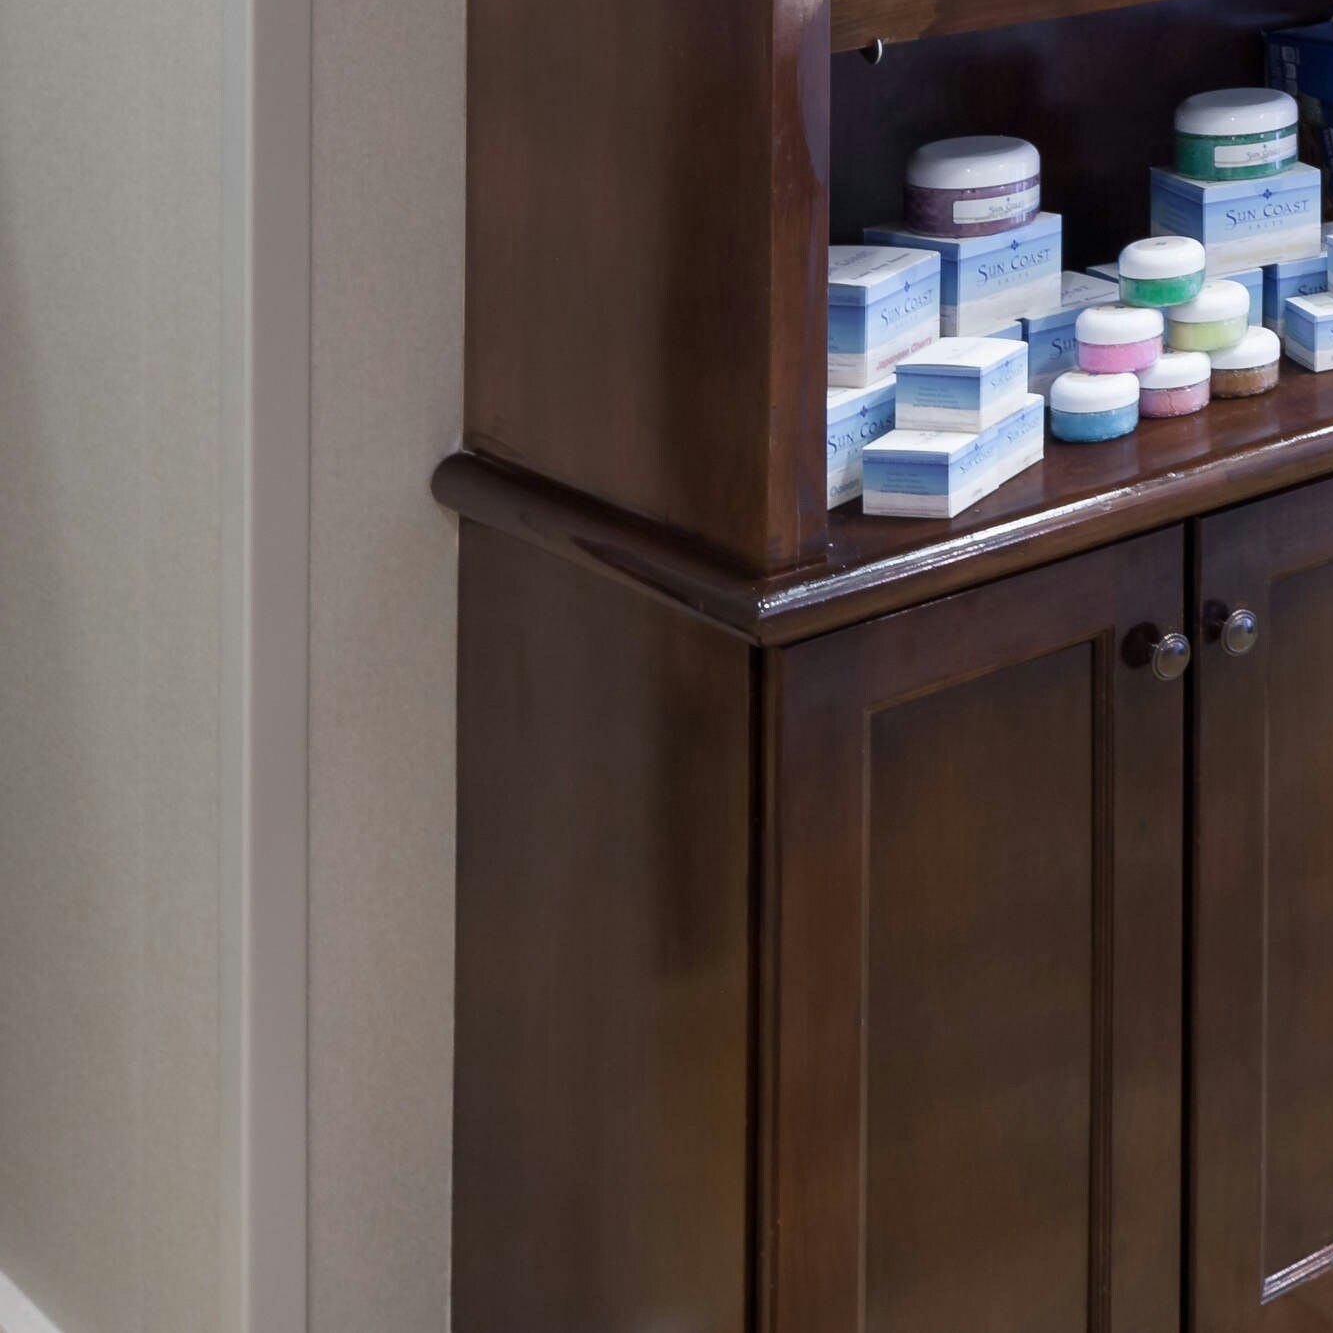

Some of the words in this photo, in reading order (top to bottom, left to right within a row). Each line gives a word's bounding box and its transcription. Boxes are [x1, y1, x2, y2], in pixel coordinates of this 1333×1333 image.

[1225, 206, 1259, 228] SUN
[1262, 199, 1309, 219] COAST
[976, 260, 1006, 284] SUN
[1010, 248, 1052, 271] COAST
[910, 336, 934, 355] Cherry
